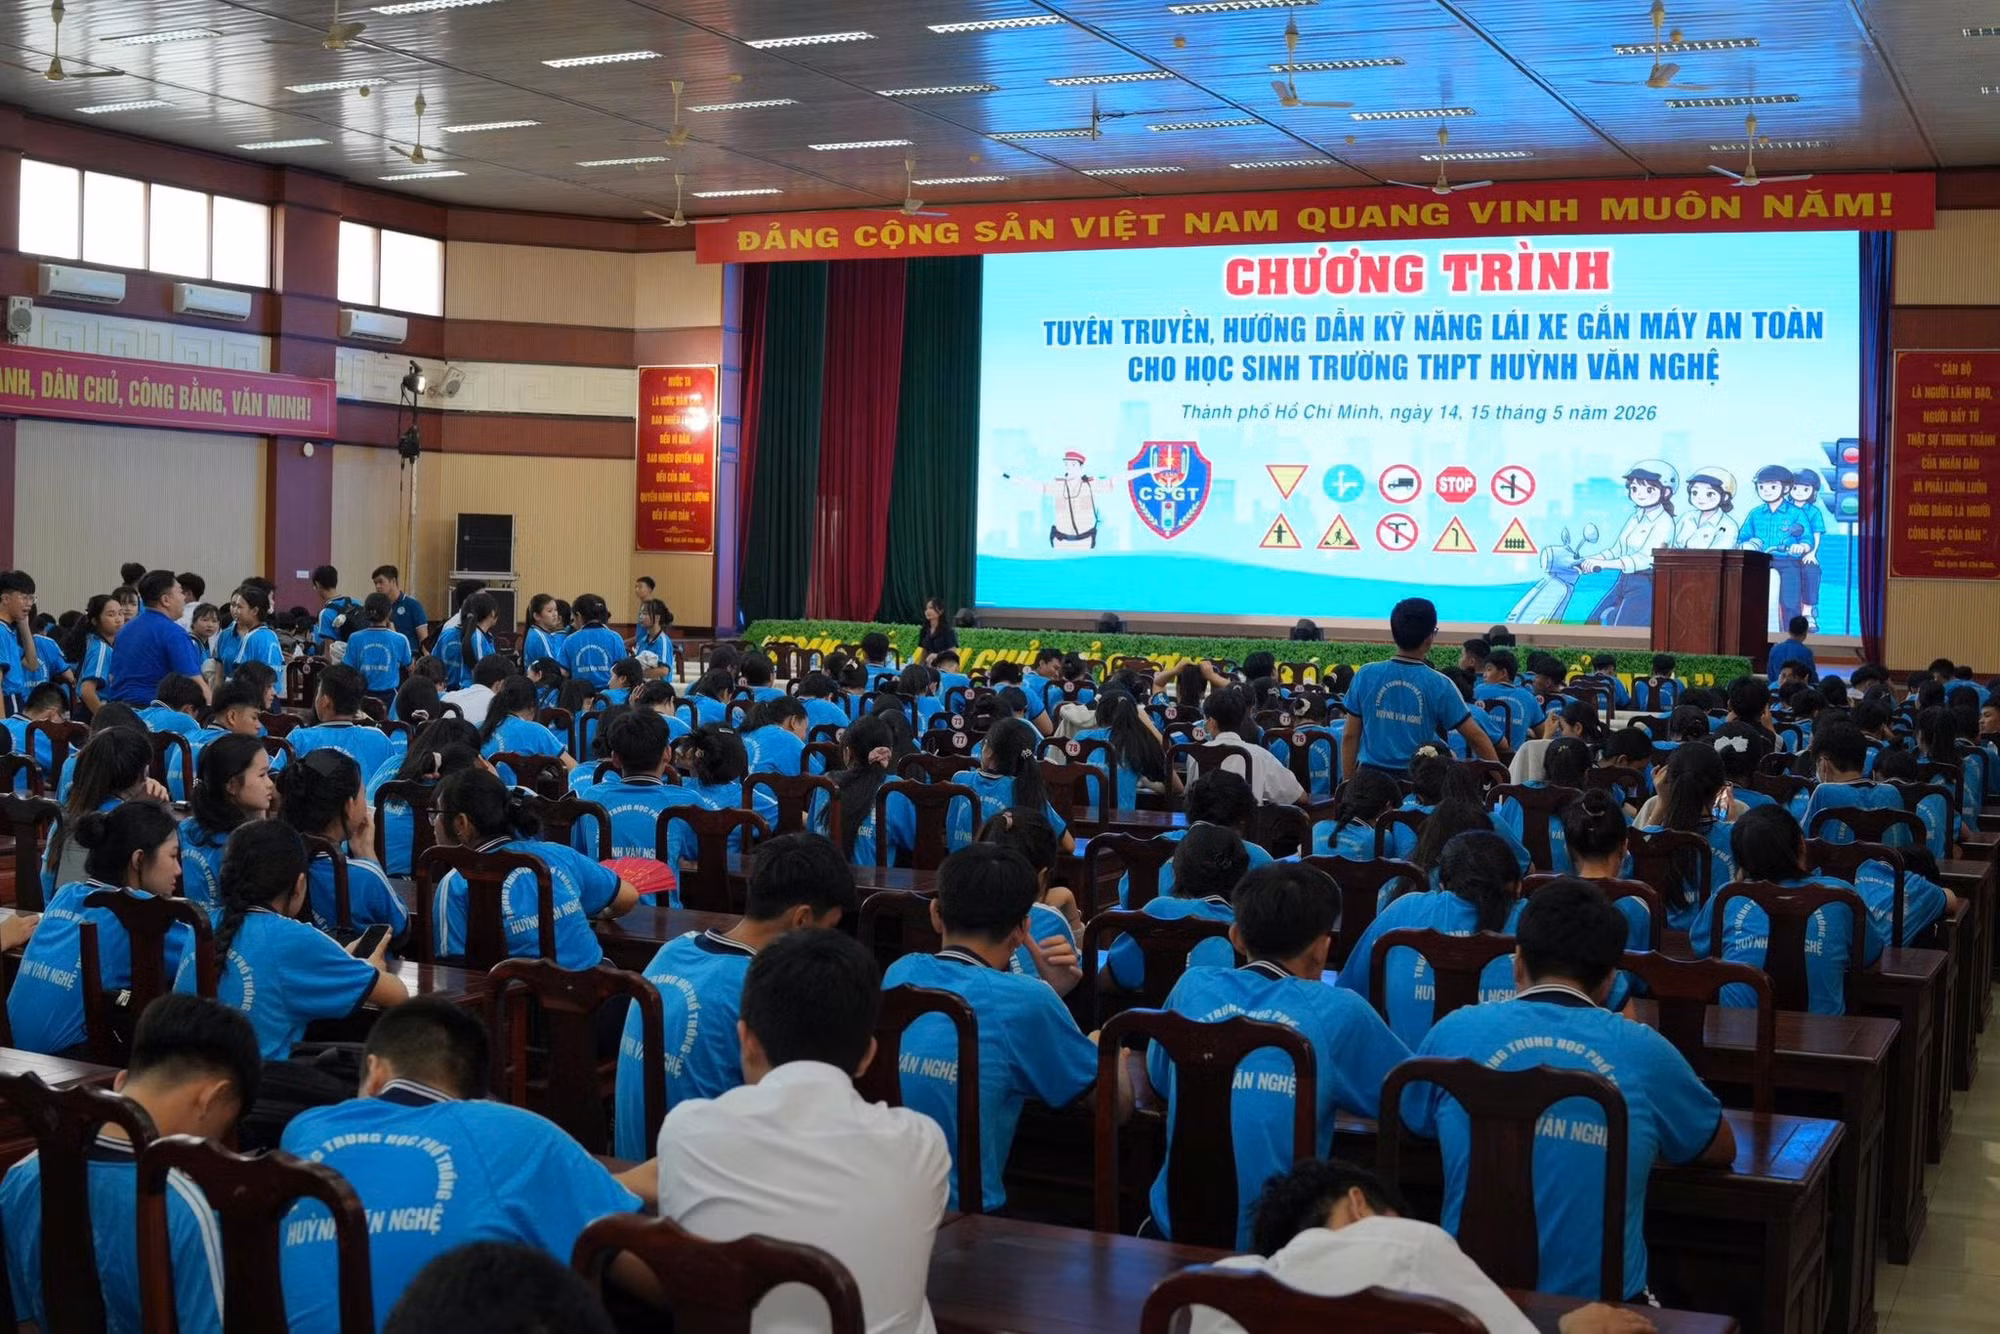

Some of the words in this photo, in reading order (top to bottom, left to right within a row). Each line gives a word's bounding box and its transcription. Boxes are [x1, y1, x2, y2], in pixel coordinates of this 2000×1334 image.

[738, 221, 839, 251] ĐẢNG
[853, 218, 960, 250] CỘNG
[973, 211, 1054, 242] SẢN
[1070, 209, 1166, 241] VIỆT
[1184, 208, 1279, 234] NAM
[1296, 202, 1450, 235] QUANG
[1467, 198, 1579, 225] VINH
[1600, 190, 1741, 222] MUÔN
[1762, 188, 1893, 218] NĂM!
[1226, 246, 1424, 296] CHƯƠNG
[1442, 241, 1610, 293] TRÌNH
[1043, 315, 1113, 346] TUYÊN
[1121, 308, 1215, 346] TRUYỀN,
[1223, 312, 1307, 343] HƯỚNG
[1315, 307, 1364, 342] DẪN
[1374, 310, 1406, 342] KỸ
[1414, 310, 1482, 341] NĂNG
[1492, 308, 1529, 341] LÁI
[1538, 313, 1568, 340] XE
[1577, 304, 1630, 340] GẮN
[1640, 307, 1698, 340] MÁY
[1706, 311, 1742, 340] AN
[1751, 306, 1823, 340] TOÀN
[1128, 355, 1176, 382] CHO
[1184, 355, 1234, 387] HỌC
[1242, 354, 1300, 382] SINH
[1308, 350, 1409, 382] TRƯỜNG
[1417, 353, 1482, 381] THPT
[1490, 348, 1578, 381] HUỲNH
[1587, 348, 1639, 381] VĂN
[1649, 347, 1720, 386] NGHỆ
[41, 367, 79, 401] DÂN
[84, 369, 123, 409] CHỦ,
[129, 378, 174, 410] CÔNG
[232, 384, 263, 418] VĂN
[266, 393, 312, 422] MINH!
[1181, 402, 1232, 420] Thành
[1237, 402, 1270, 423] phố
[1275, 400, 1299, 420] Hồ
[1303, 402, 1332, 420] Chí
[1390, 403, 1433, 423] ngày
[1471, 404, 1490, 420] 15
[1495, 403, 1547, 424] tháng
[1553, 404, 1563, 420] 5
[1569, 404, 1608, 421] năm
[1613, 404, 1658, 421] 2026
[1439, 476, 1474, 493] STOP
[955, 735, 965, 745] 77
[1068, 743, 1078, 753] 78
[1735, 933, 1769, 950] HUỲNH
[1804, 938, 1824, 957] GHỆ
[233, 955, 254, 975] PHỔ
[48, 969, 78, 991] NGHỆ
[241, 974, 256, 1012] THÔNG
[681, 1011, 699, 1054] THÔNG
[899, 1052, 920, 1074] ĂN
[1506, 1036, 1553, 1053] TRUNG
[1556, 1038, 1586, 1055] HỌC
[1584, 1049, 1616, 1074] PHỔ
[1231, 1068, 1255, 1090] ĂN
[322, 1132, 383, 1153] TRUNG
[384, 1134, 420, 1147] HỌC
[416, 1137, 452, 1158] PHỔ
[434, 1152, 459, 1201] THÔNG
[387, 1202, 445, 1236] NGHỆ
